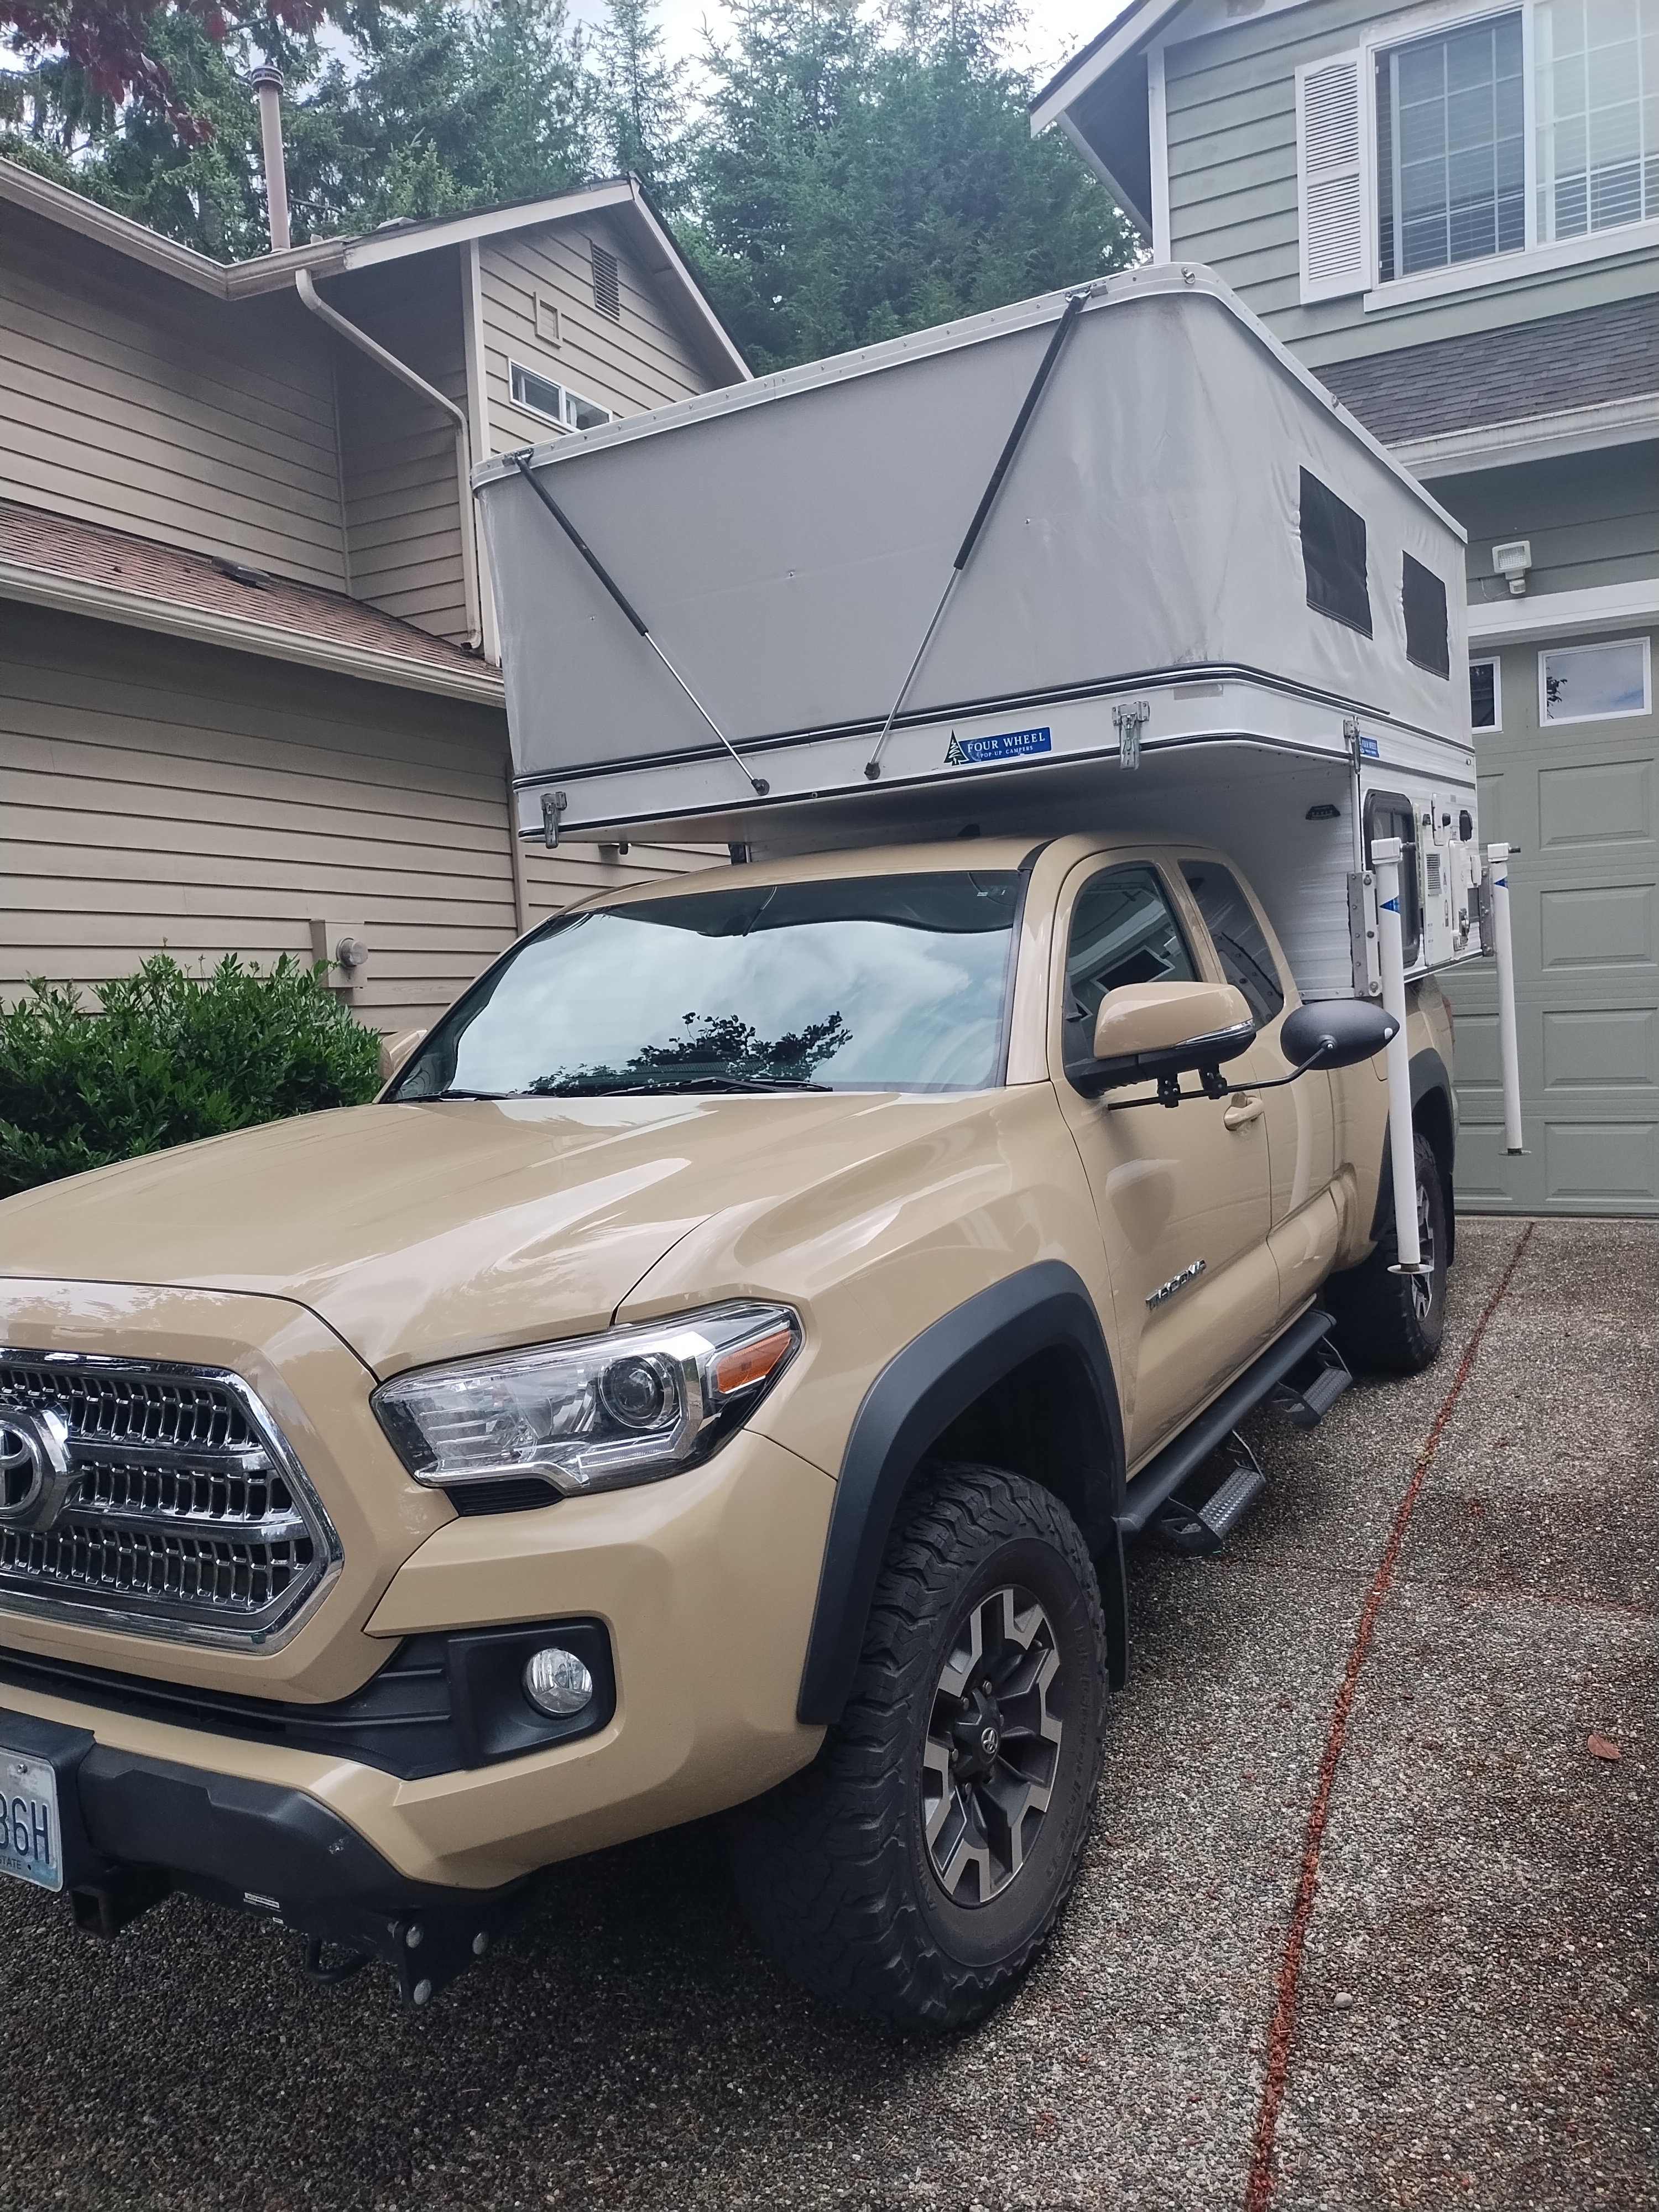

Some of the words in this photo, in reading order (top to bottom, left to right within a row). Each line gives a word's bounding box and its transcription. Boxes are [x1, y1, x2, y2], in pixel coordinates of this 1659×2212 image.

[968, 740, 999, 753] FOUR
[1003, 732, 1045, 747] WHEEL
[1005, 745, 1034, 755] CAMPERS
[0, 1855, 22, 1870] TATE
